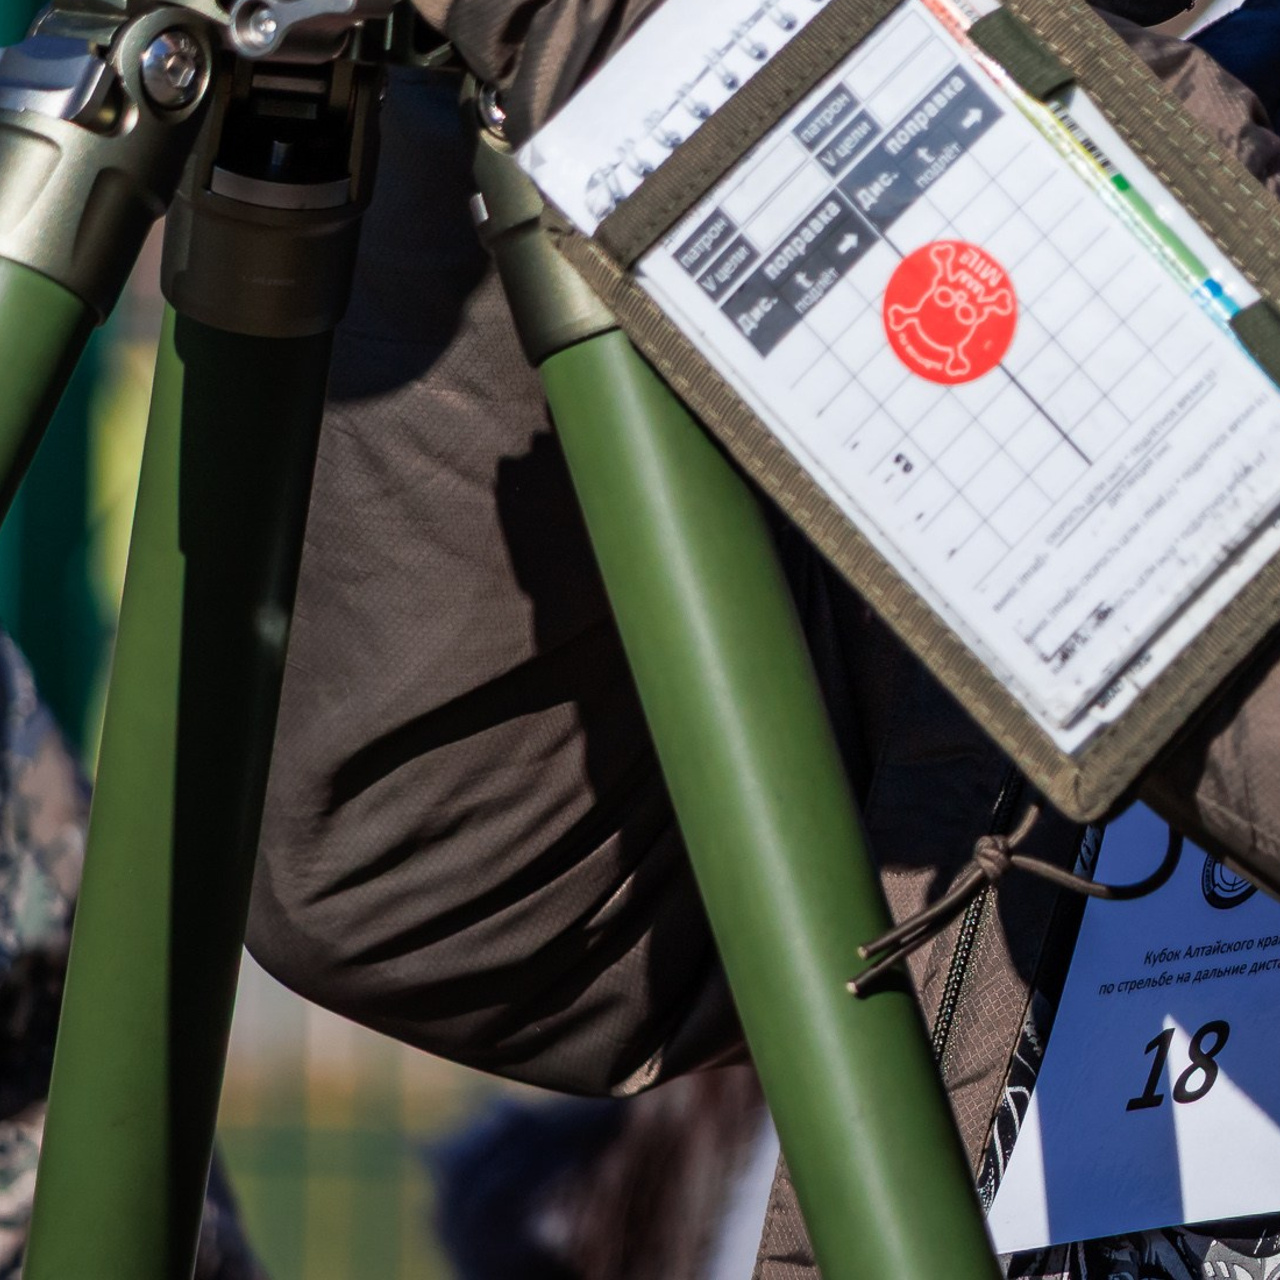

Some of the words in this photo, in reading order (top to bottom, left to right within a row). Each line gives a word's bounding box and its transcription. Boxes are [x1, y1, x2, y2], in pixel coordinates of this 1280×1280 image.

[800, 93, 849, 142] патрон
[884, 75, 966, 155] поправка
[679, 218, 728, 268] патрон
[764, 201, 841, 280] поправка
[1143, 947, 1181, 965] Кубок
[1183, 939, 1254, 960] Алтайского
[1098, 982, 1114, 995] по
[1117, 973, 1173, 994] стрельбе
[1176, 972, 1190, 984] на
[1192, 962, 1247, 983] дальние
[1125, 1019, 1230, 1112] 18
